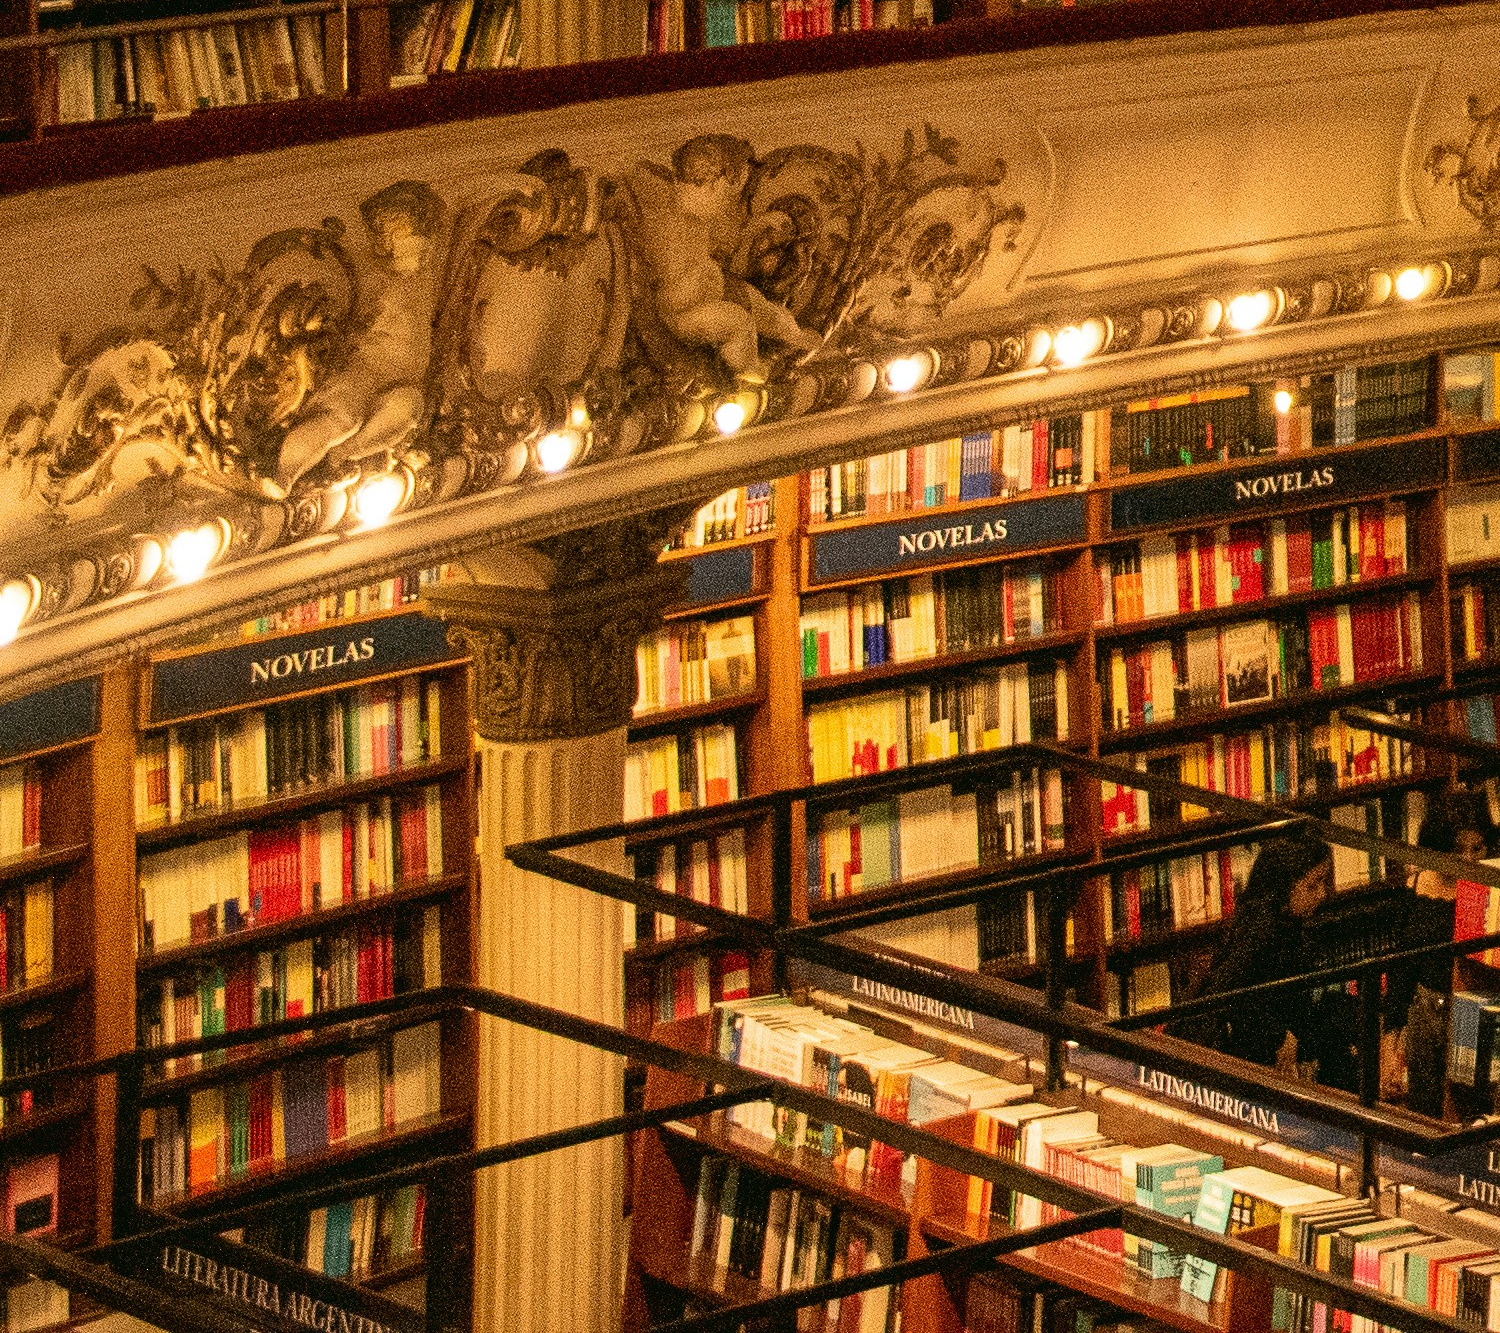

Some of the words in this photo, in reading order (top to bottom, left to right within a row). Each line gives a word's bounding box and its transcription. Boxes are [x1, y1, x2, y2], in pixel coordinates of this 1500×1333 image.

[1235, 467, 1335, 501] NOVELAS
[899, 519, 1008, 556] NOVELAS
[250, 637, 375, 684] NOVELAS
[852, 975, 974, 1030] LATINOAMERICANA
[1138, 1064, 1280, 1134] LATINOAMERICANA
[161, 1244, 282, 1315] LITERATURA
